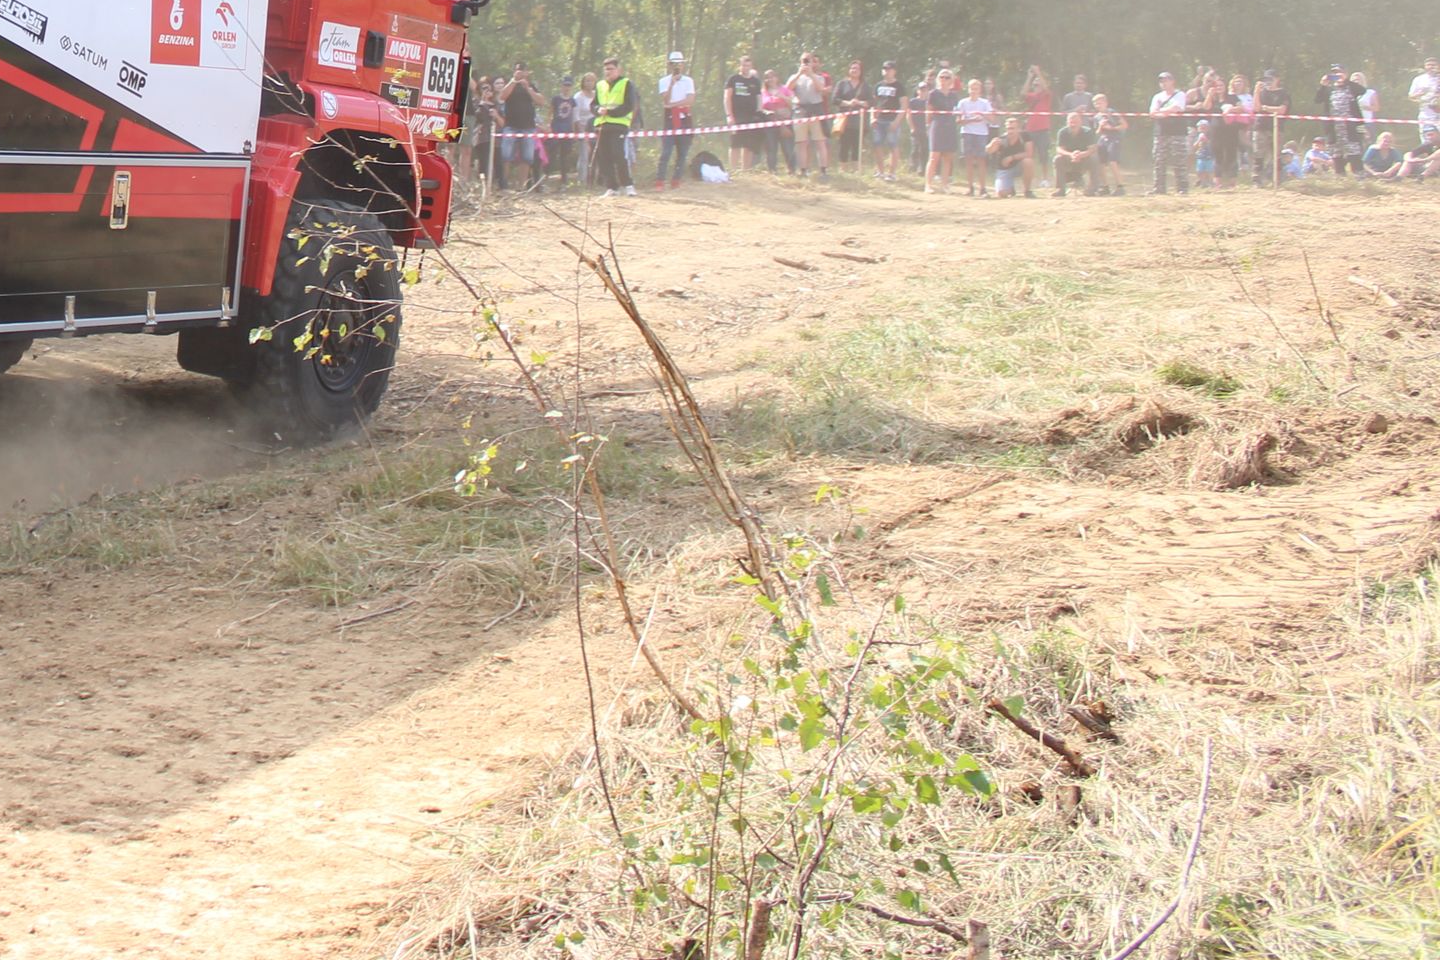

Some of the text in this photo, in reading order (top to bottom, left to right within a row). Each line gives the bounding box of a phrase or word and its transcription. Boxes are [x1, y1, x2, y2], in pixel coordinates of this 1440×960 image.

[158, 34, 195, 46] BENZINA
[212, 30, 237, 42] ORLEN
[72, 42, 109, 72] SATUM
[334, 50, 356, 64] ORLEN
[389, 40, 422, 61] MOTUL
[118, 66, 147, 92] OMP
[427, 55, 455, 94] 683
